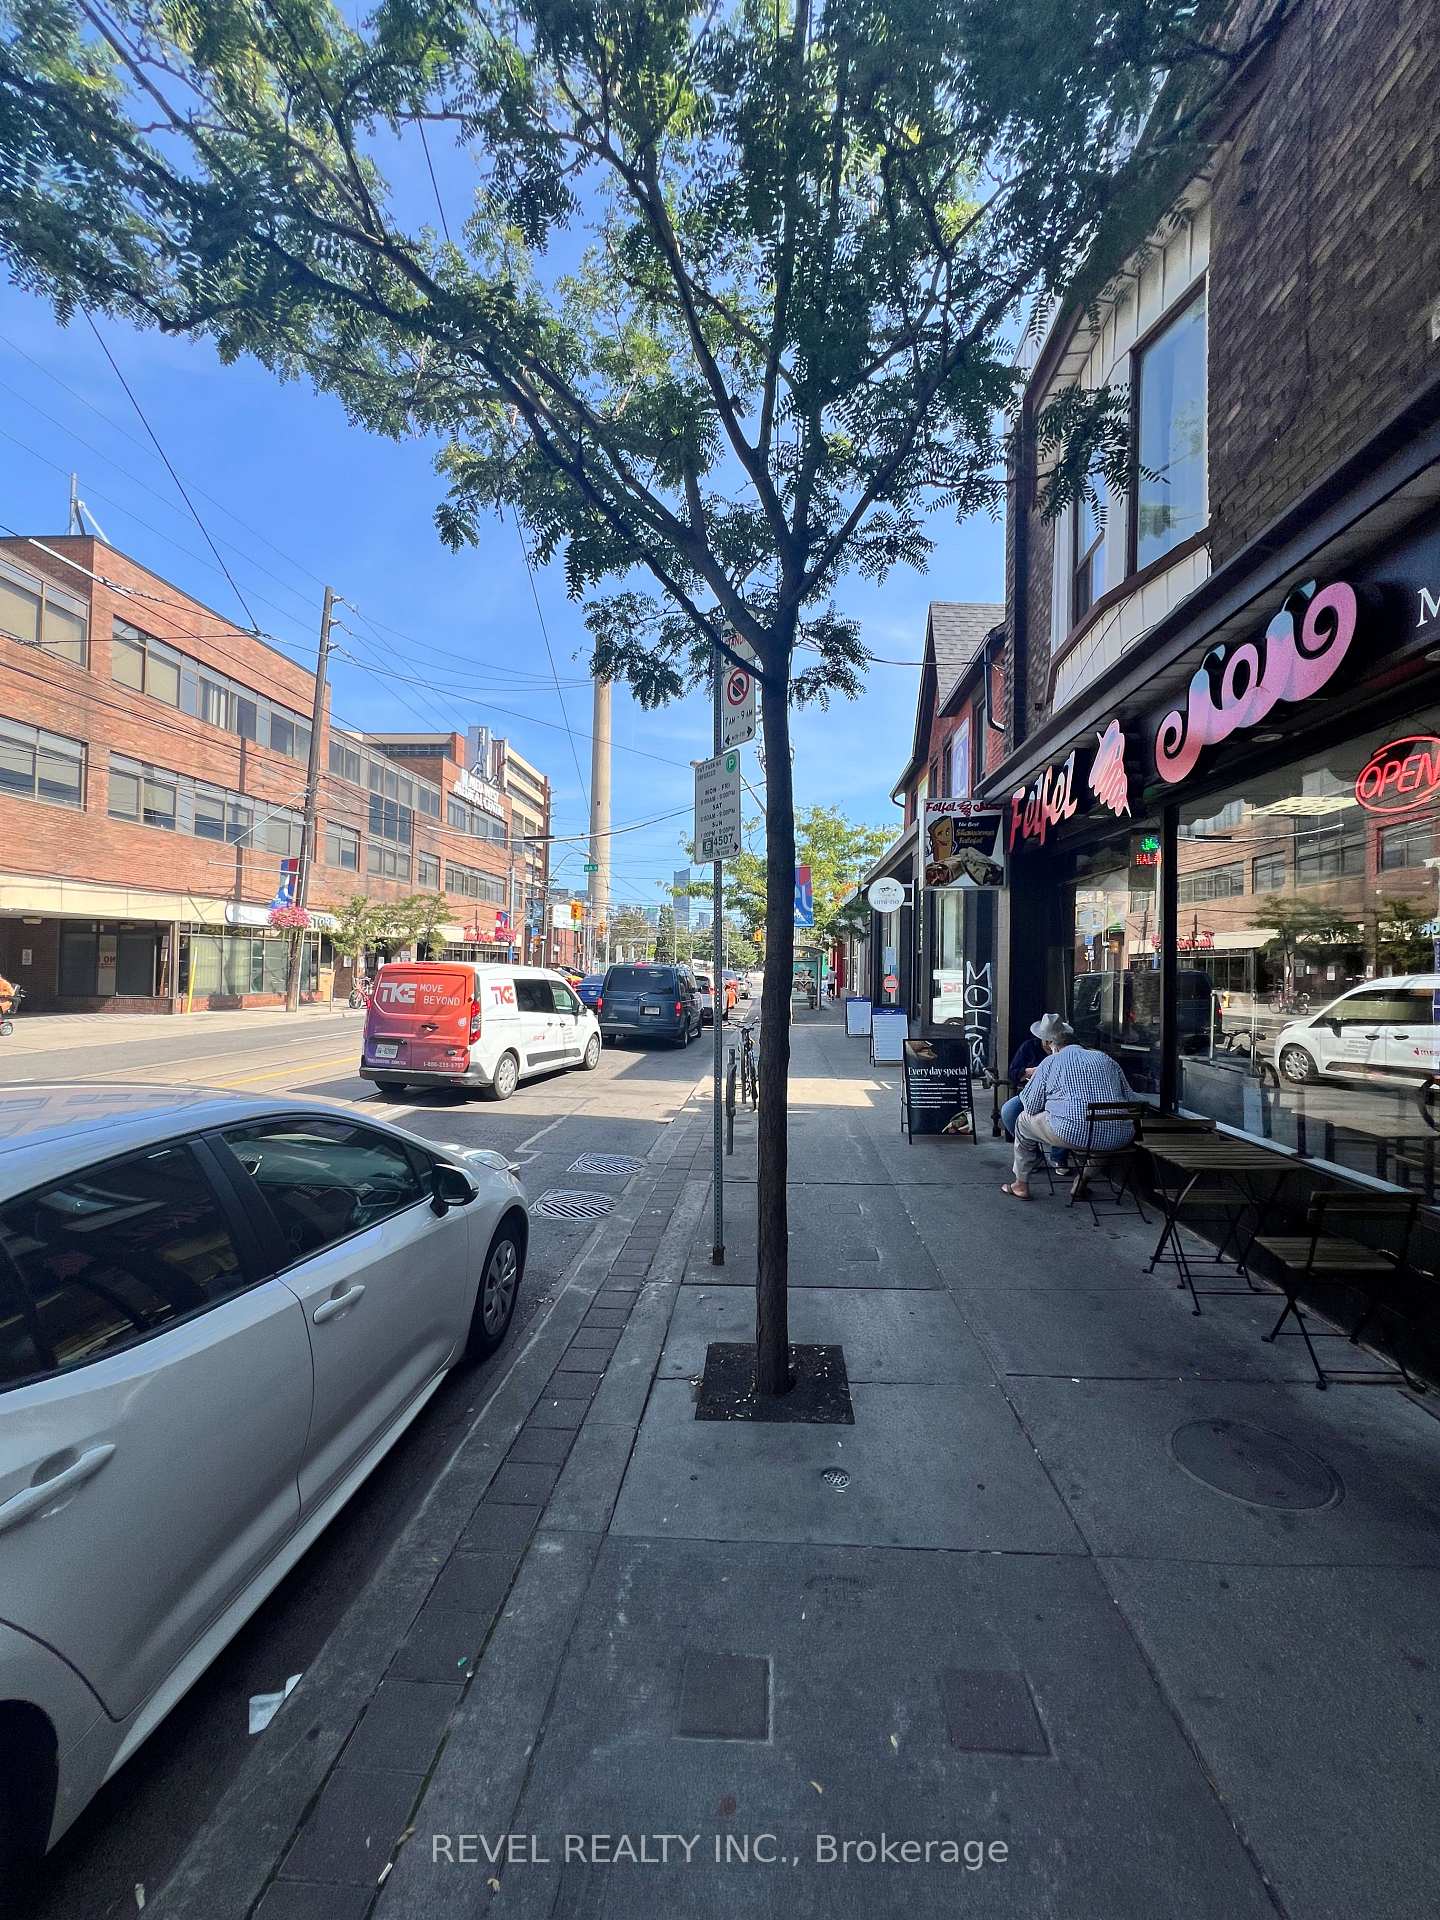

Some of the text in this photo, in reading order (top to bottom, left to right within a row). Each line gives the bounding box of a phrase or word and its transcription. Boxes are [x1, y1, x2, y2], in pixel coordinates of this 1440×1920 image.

[1360, 750, 1440, 799] OPEN
[712, 802, 723, 811] SAT
[1008, 750, 1078, 853] Felfel
[714, 833, 734, 846] 4507
[419, 983, 445, 992] MOVE
[423, 995, 461, 1006] BEYOND
[943, 1067, 968, 1078] special
